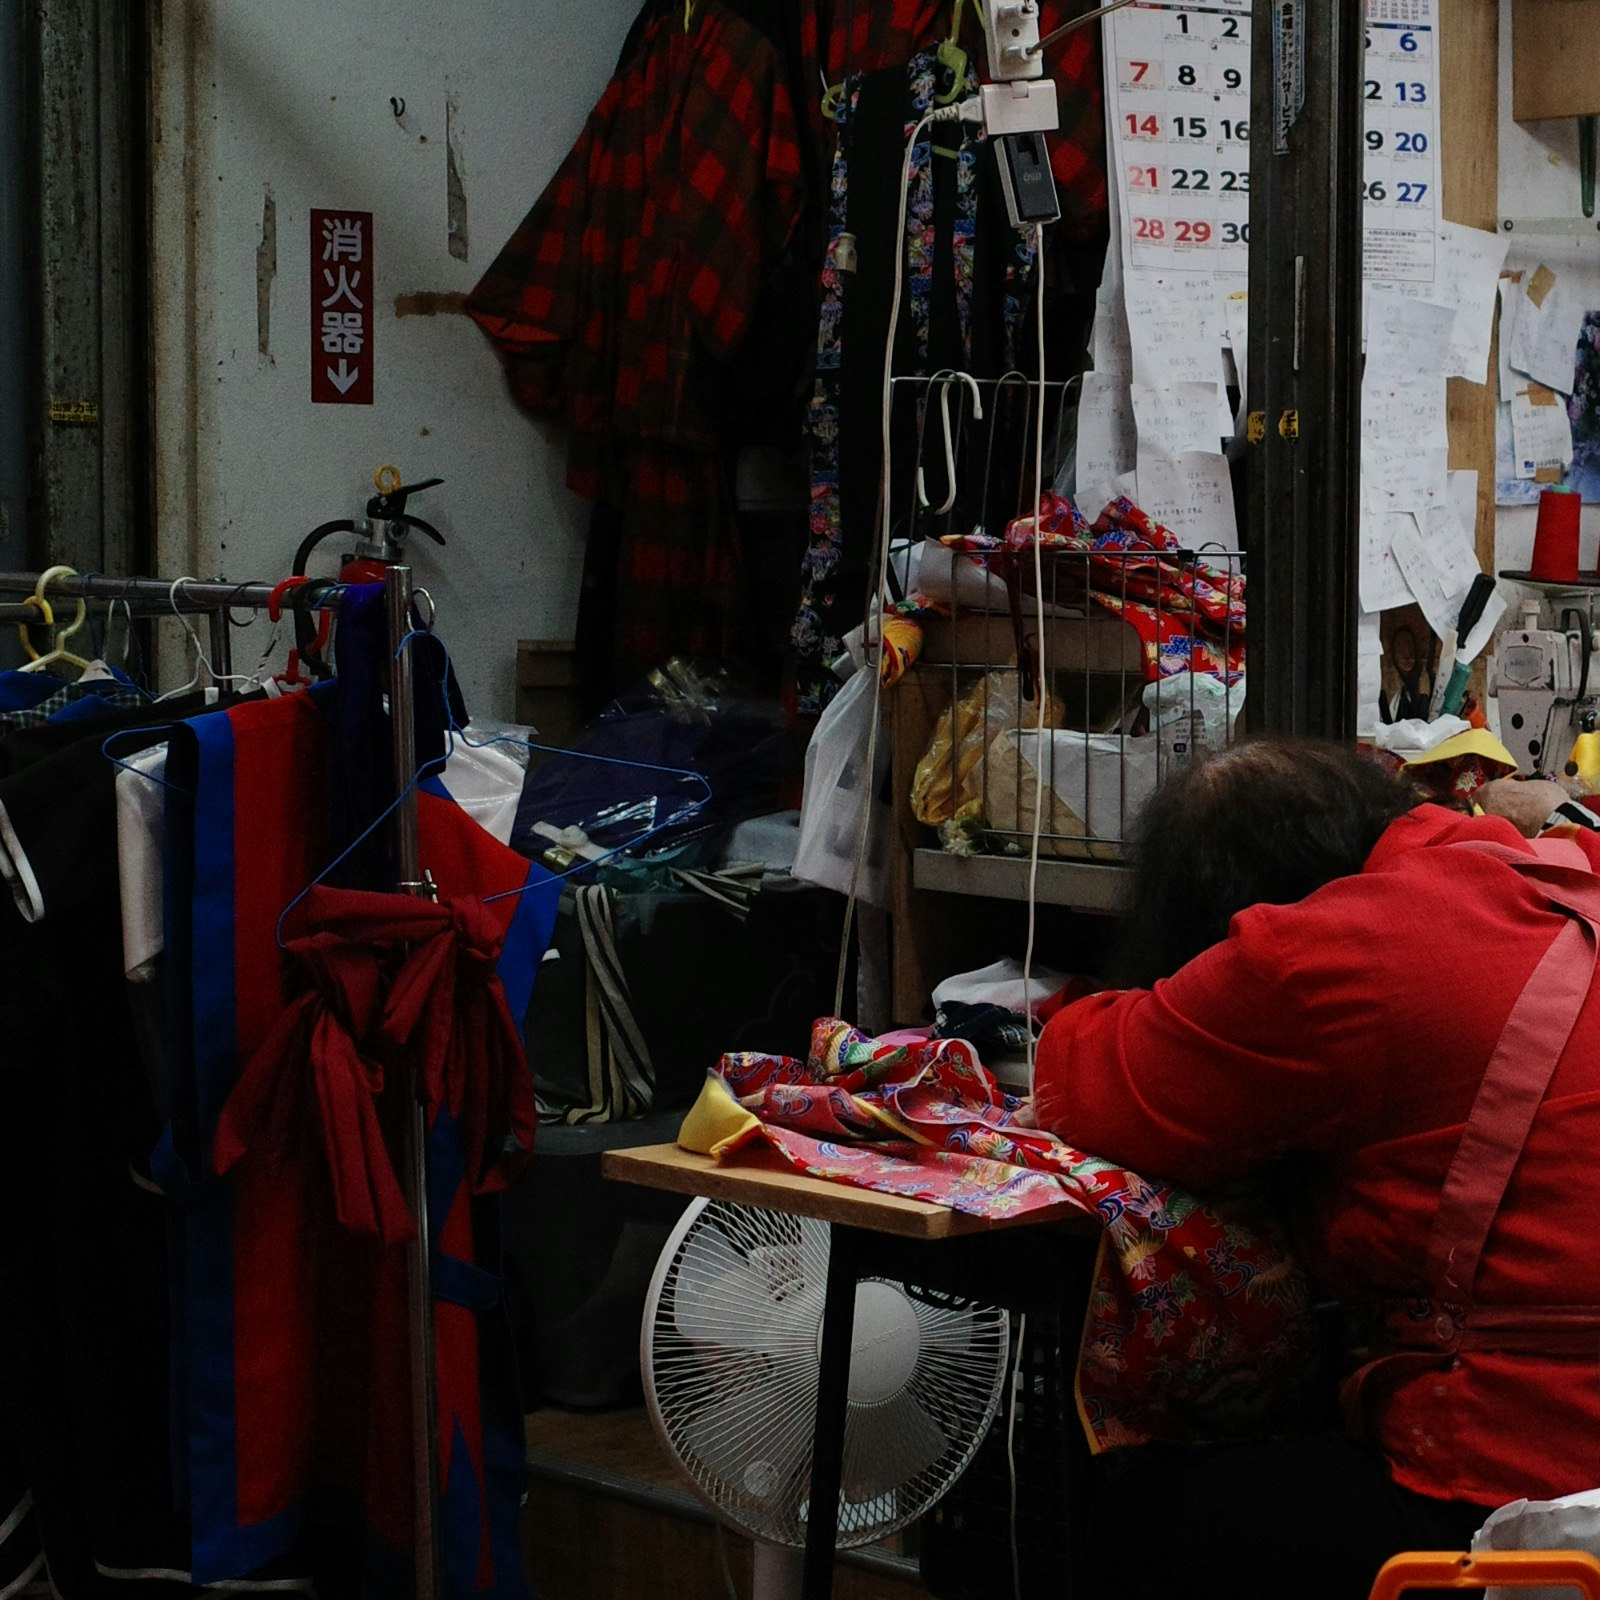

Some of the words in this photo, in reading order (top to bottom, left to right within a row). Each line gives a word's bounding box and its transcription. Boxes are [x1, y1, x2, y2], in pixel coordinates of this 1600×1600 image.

[1176, 13, 1188, 34] 1
[1221, 17, 1239, 38] 2
[1400, 33, 1418, 51] 6
[1129, 61, 1149, 82] 7
[1177, 65, 1196, 86] 8
[1223, 68, 1241, 89] 9
[1395, 82, 1426, 102] 13
[1125, 114, 1159, 136] 14
[1173, 116, 1207, 138] 15
[1220, 119, 1249, 141] 16
[1395, 132, 1427, 152] 20
[1129, 165, 1157, 188] 21
[1171, 168, 1210, 191] 22
[1220, 170, 1250, 193] 23
[1397, 182, 1427, 203] 27
[1133, 216, 1165, 240] 28
[1174, 220, 1211, 243] 29
[321, 218, 364, 354] 消火器
